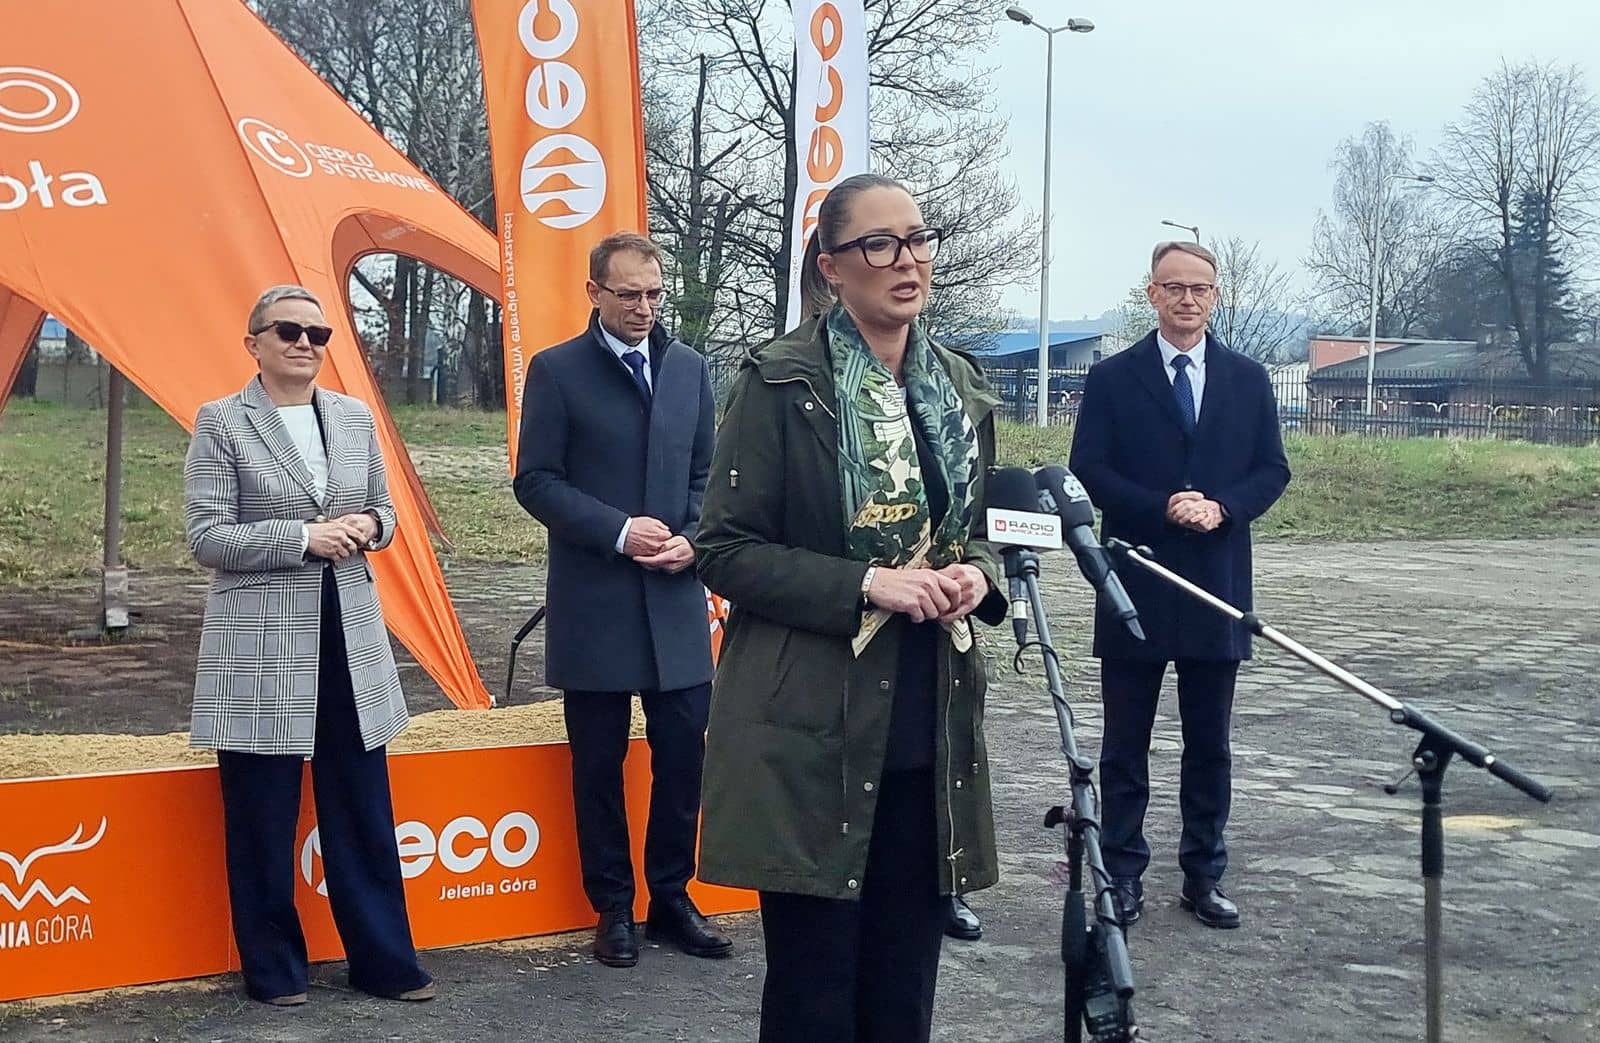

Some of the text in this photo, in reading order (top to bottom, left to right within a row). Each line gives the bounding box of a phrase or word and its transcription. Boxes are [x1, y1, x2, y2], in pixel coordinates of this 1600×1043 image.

[304, 142, 374, 168] CIEPŁO
[317, 159, 436, 193] SYSTEMOWE
[1008, 520, 1055, 532] RADIO
[395, 811, 540, 879] eco
[439, 877, 537, 900] Jelenia Góra
[35, 914, 93, 945] GÓRA
